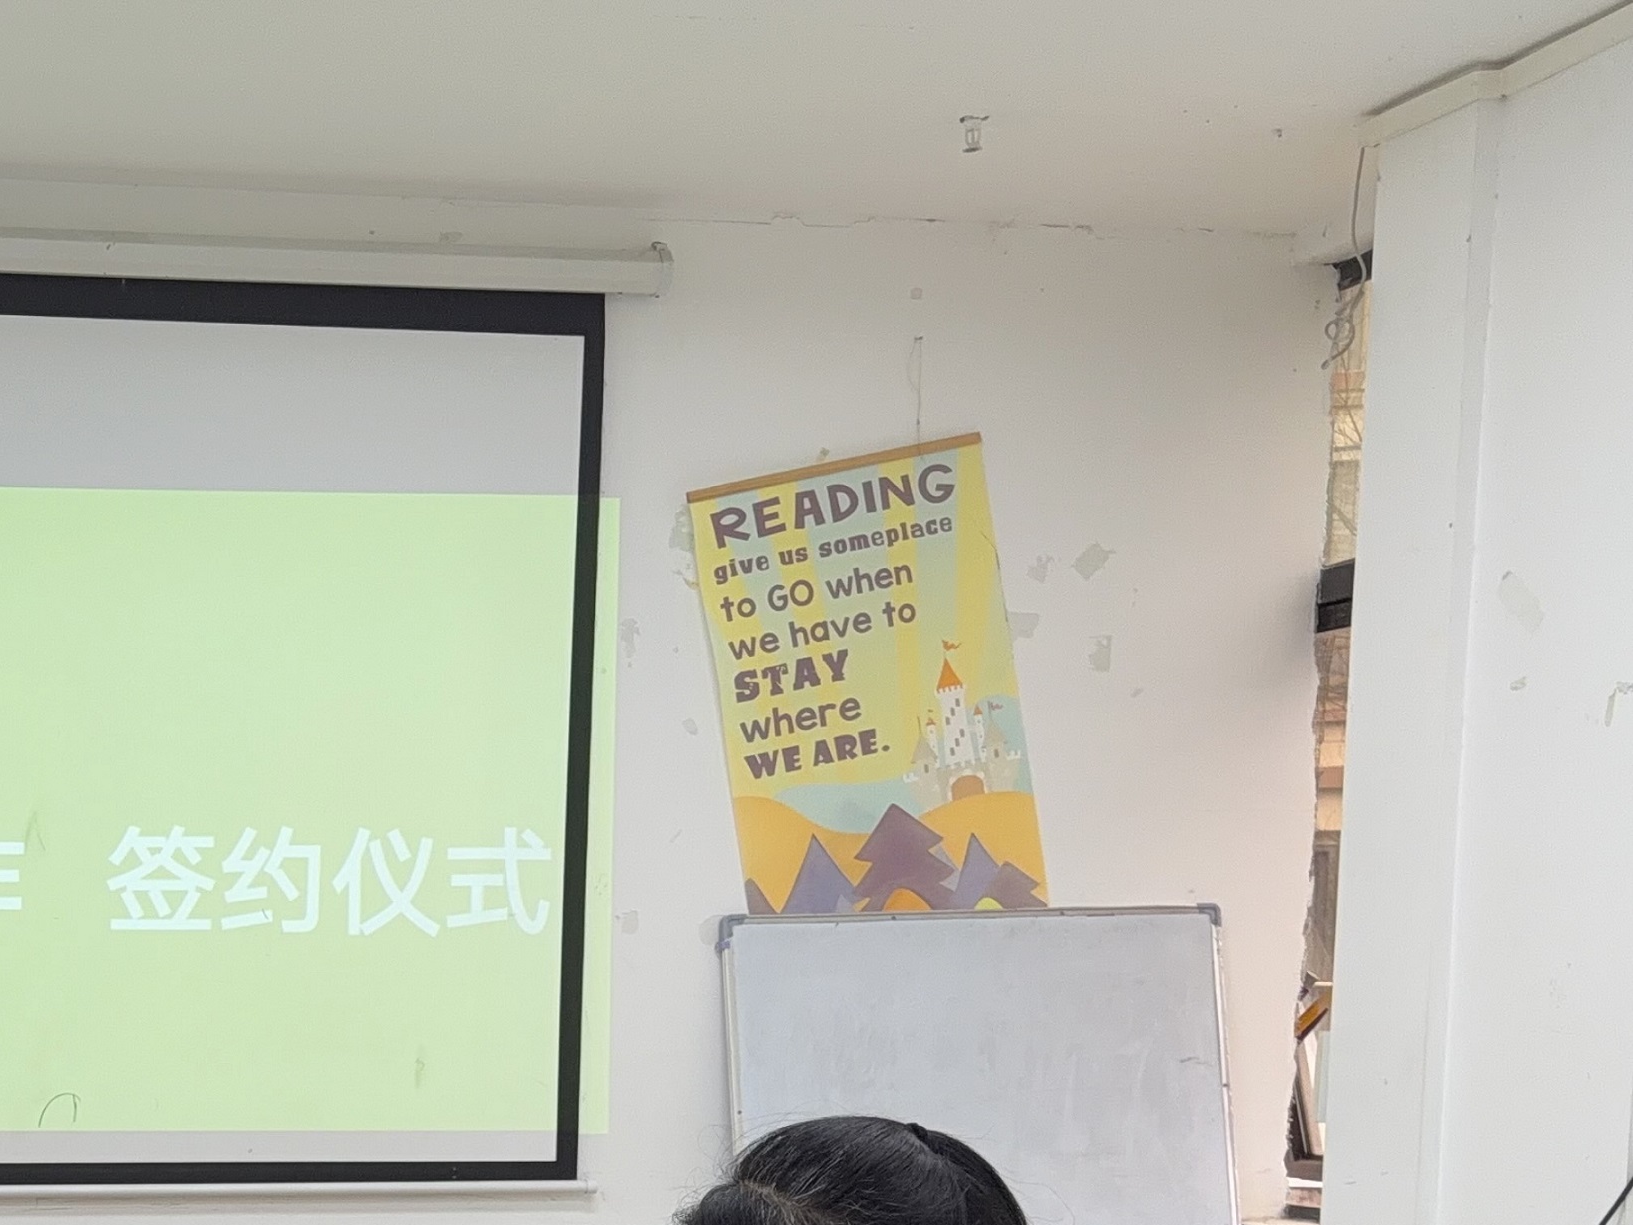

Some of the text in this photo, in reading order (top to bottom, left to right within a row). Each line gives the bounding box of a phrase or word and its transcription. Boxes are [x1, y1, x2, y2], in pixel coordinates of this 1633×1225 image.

[710, 464, 954, 549] READING
[713, 516, 952, 585] give us someplace
[720, 564, 913, 622] to GO when
[728, 601, 916, 660] we have to
[734, 649, 848, 703] STAY
[739, 697, 862, 743] where
[743, 728, 890, 780] WE ARE.
[106, 825, 553, 938] 签约仪式
